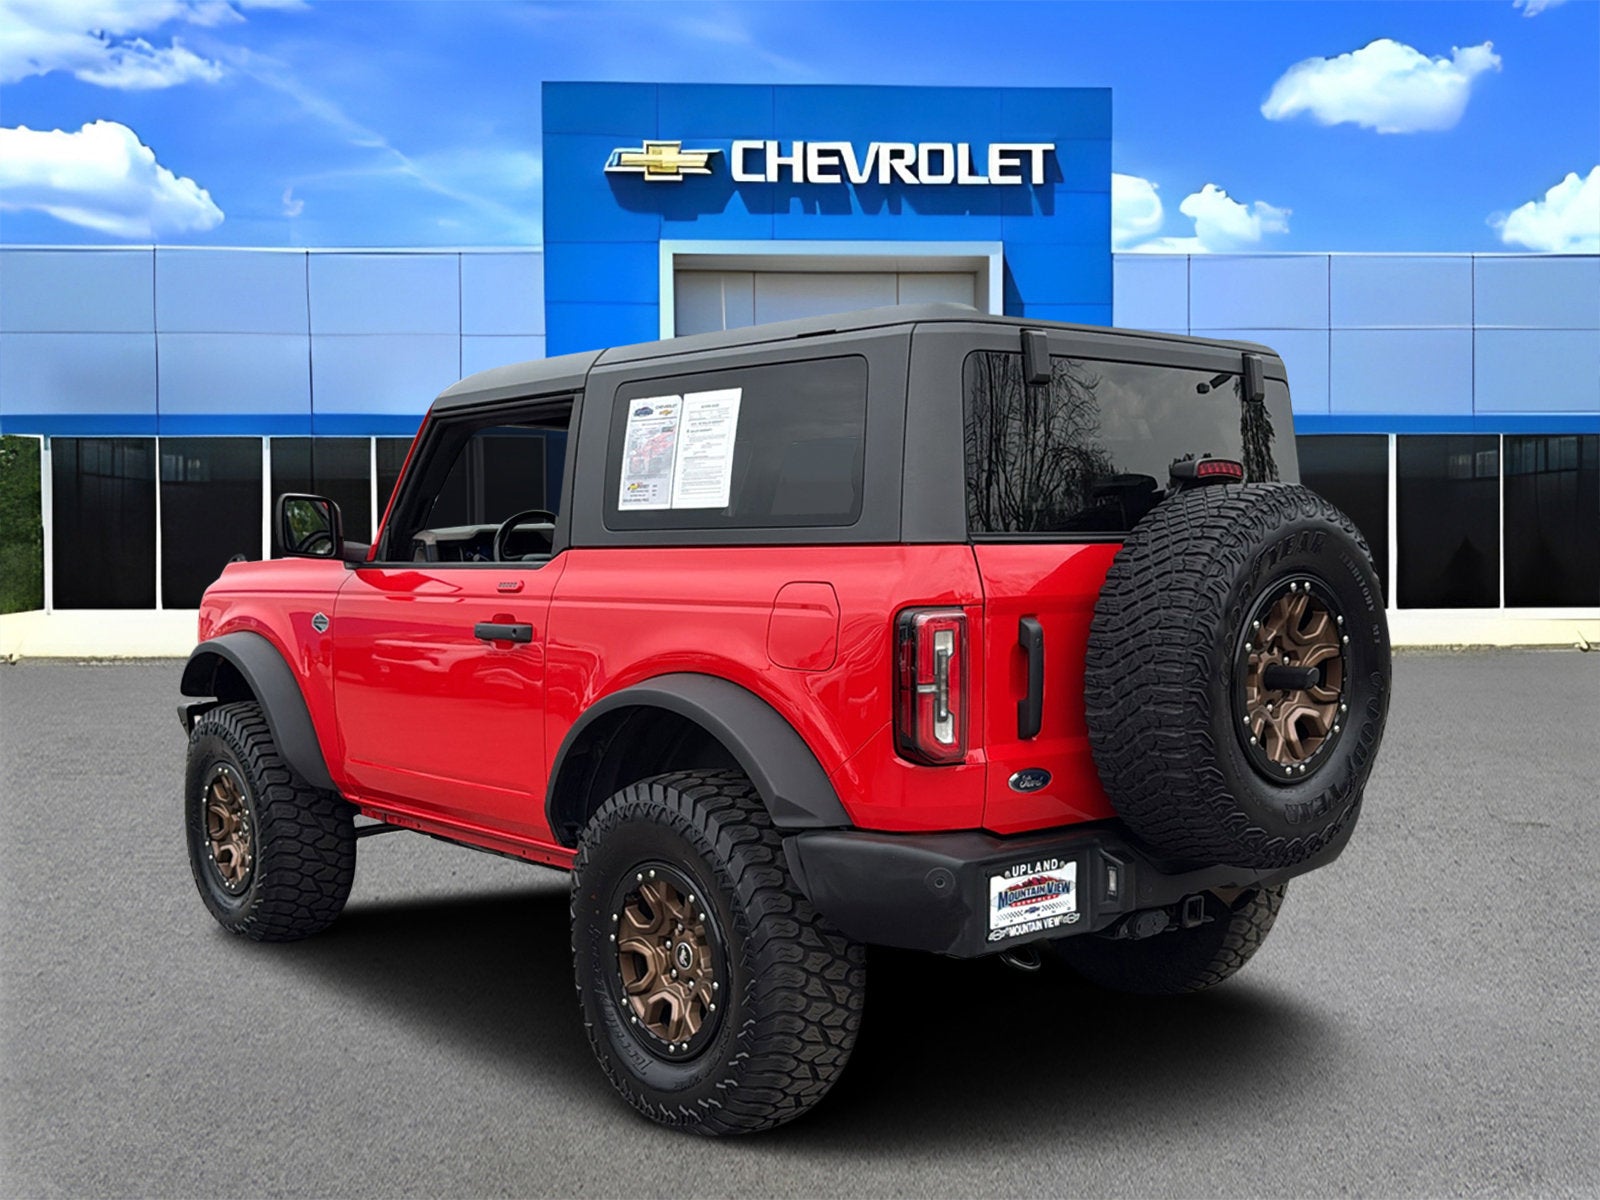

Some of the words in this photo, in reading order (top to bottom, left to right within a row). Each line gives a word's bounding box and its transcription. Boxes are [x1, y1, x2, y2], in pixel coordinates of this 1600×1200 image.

[731, 140, 1055, 185] CHEVROLET
[1019, 774, 1044, 789] Ford
[1012, 859, 1058, 877] UPLAND
[1044, 915, 1061, 928] VIEW
